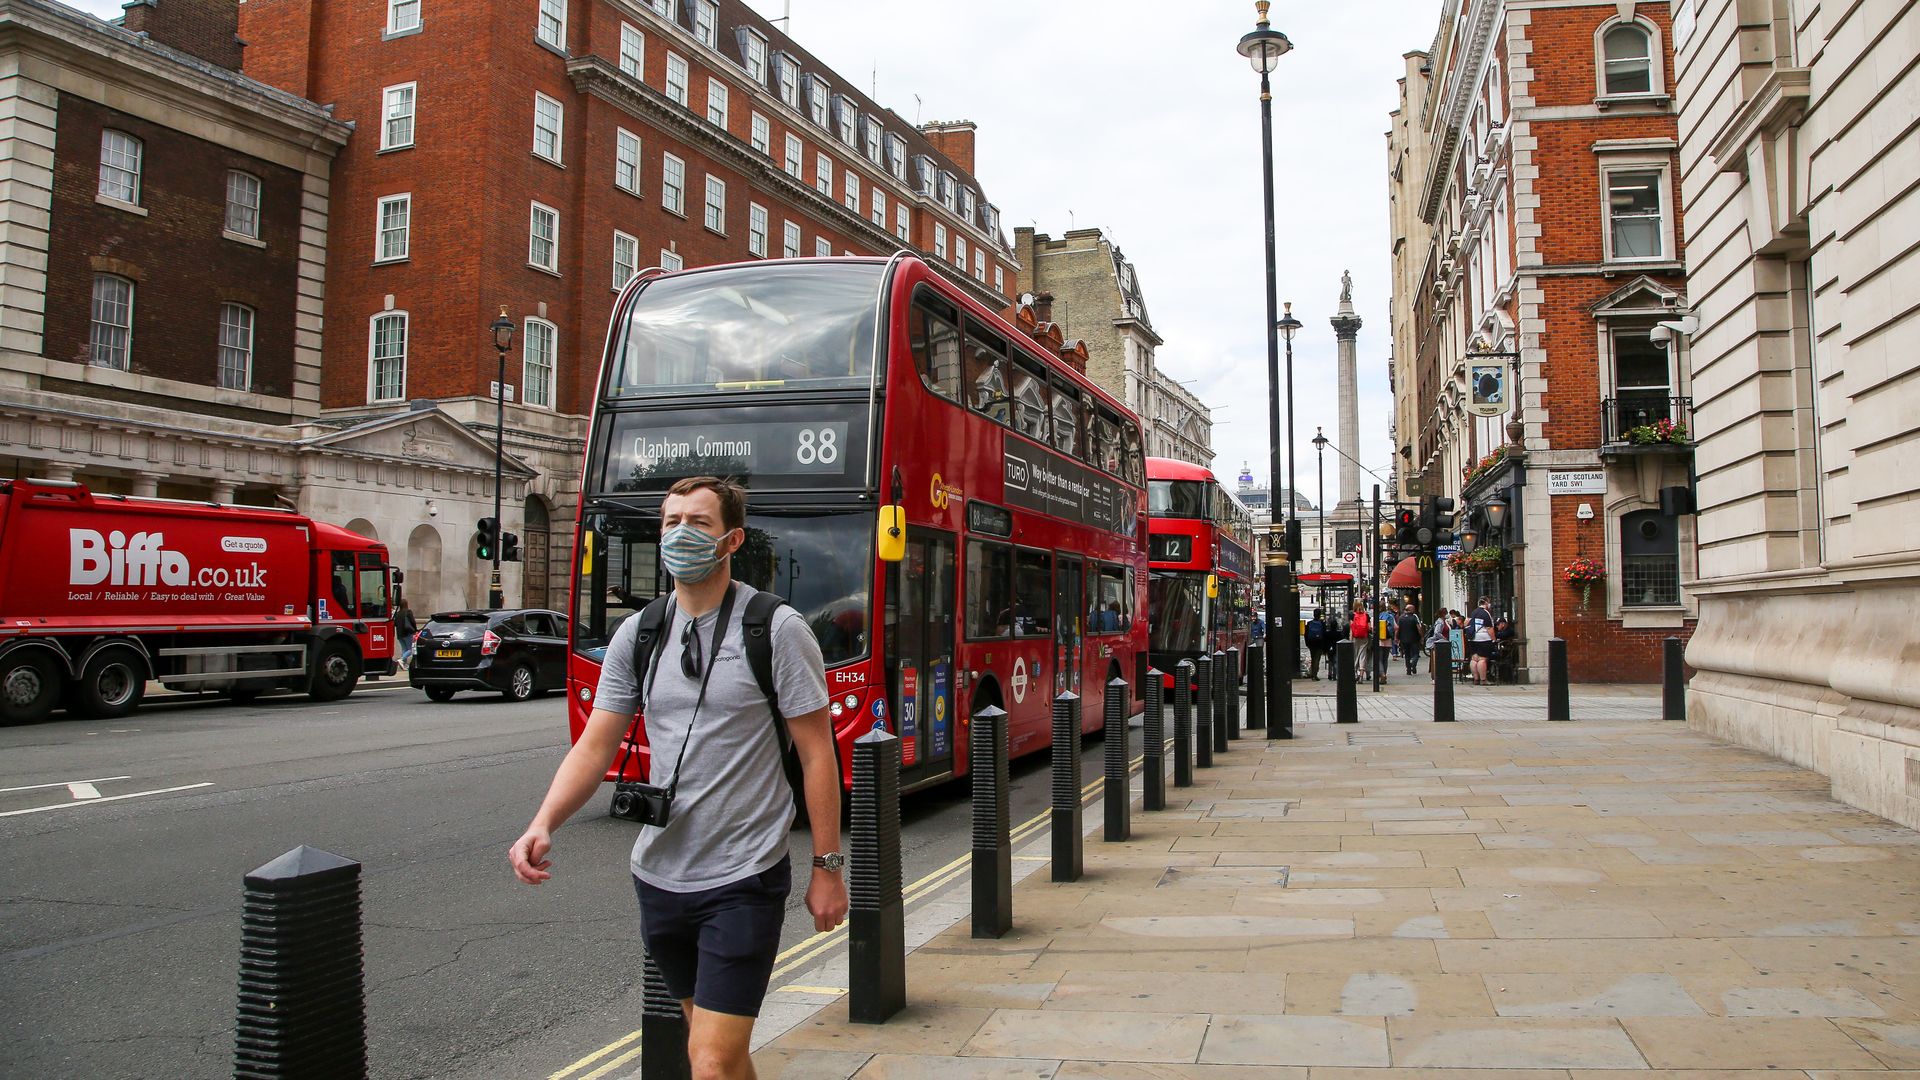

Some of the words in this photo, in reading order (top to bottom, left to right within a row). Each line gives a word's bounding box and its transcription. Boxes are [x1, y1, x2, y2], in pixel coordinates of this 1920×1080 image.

[634, 437, 690, 465] Clapham
[696, 435, 751, 457] Common
[797, 428, 838, 465] 88
[1007, 463, 1026, 482] TURO
[1032, 464, 1042, 483] Way
[1057, 474, 1068, 490] than
[224, 540, 238, 549] Get
[244, 541, 264, 550] quote
[1165, 541, 1180, 556] 12
[68, 592, 92, 600] Local
[104, 592, 139, 600] Reliable
[150, 592, 170, 602] Easy
[180, 592, 197, 601] deal
[198, 592, 215, 601] with
[224, 593, 244, 601] Great
[245, 593, 265, 601] Value
[835, 672, 865, 683] EH34
[904, 702, 914, 721] 30
